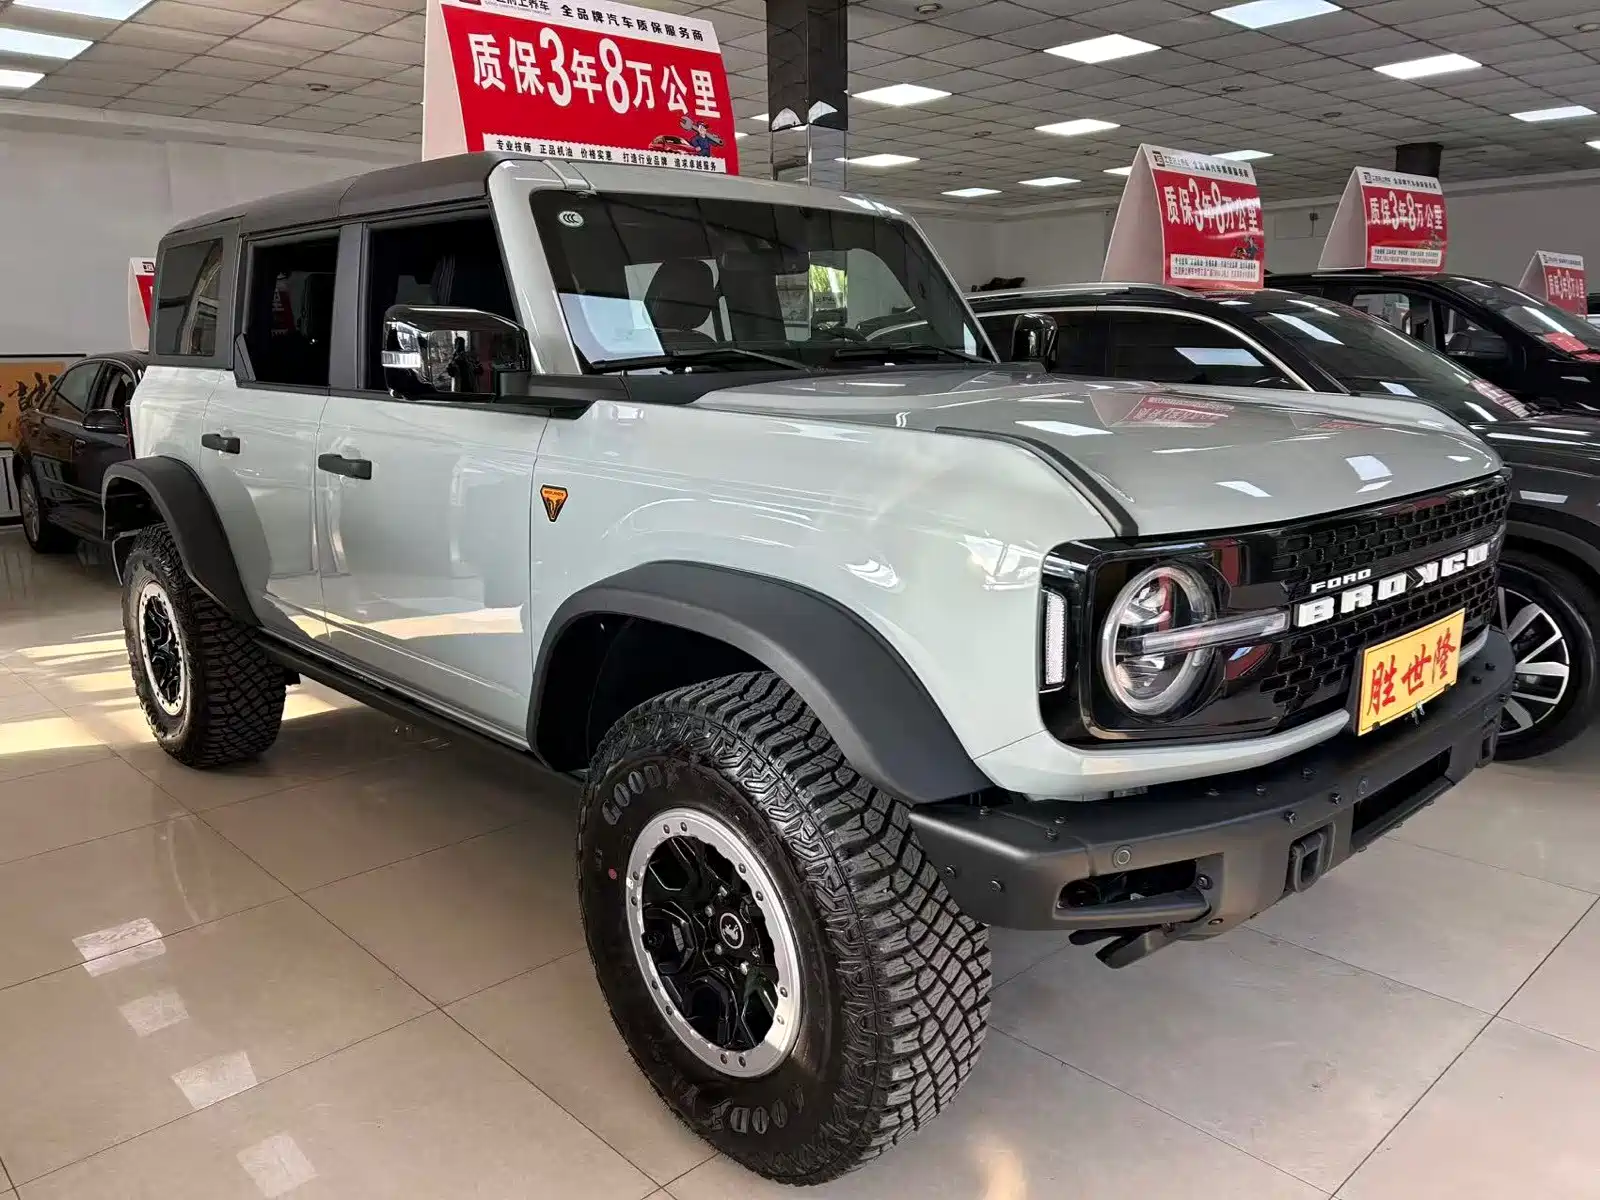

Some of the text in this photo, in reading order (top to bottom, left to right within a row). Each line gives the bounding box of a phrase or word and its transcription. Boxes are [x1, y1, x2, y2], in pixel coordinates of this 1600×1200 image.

[560, 4, 704, 42] 全品牌汽车质保服务商
[467, 27, 721, 119] 质保3年8万公里
[496, 139, 532, 153] 专业技师
[539, 144, 573, 157] 正品机油
[580, 147, 613, 161] 价格实惠
[623, 151, 668, 166] 打造行业品牌
[1163, 177, 1261, 233] 质保3年8万公里
[1368, 190, 1444, 232] 质保3年8万公里
[1296, 542, 1490, 627] BRONCO
[1310, 568, 1372, 594] FORD
[1366, 627, 1457, 716] 胜世隆
